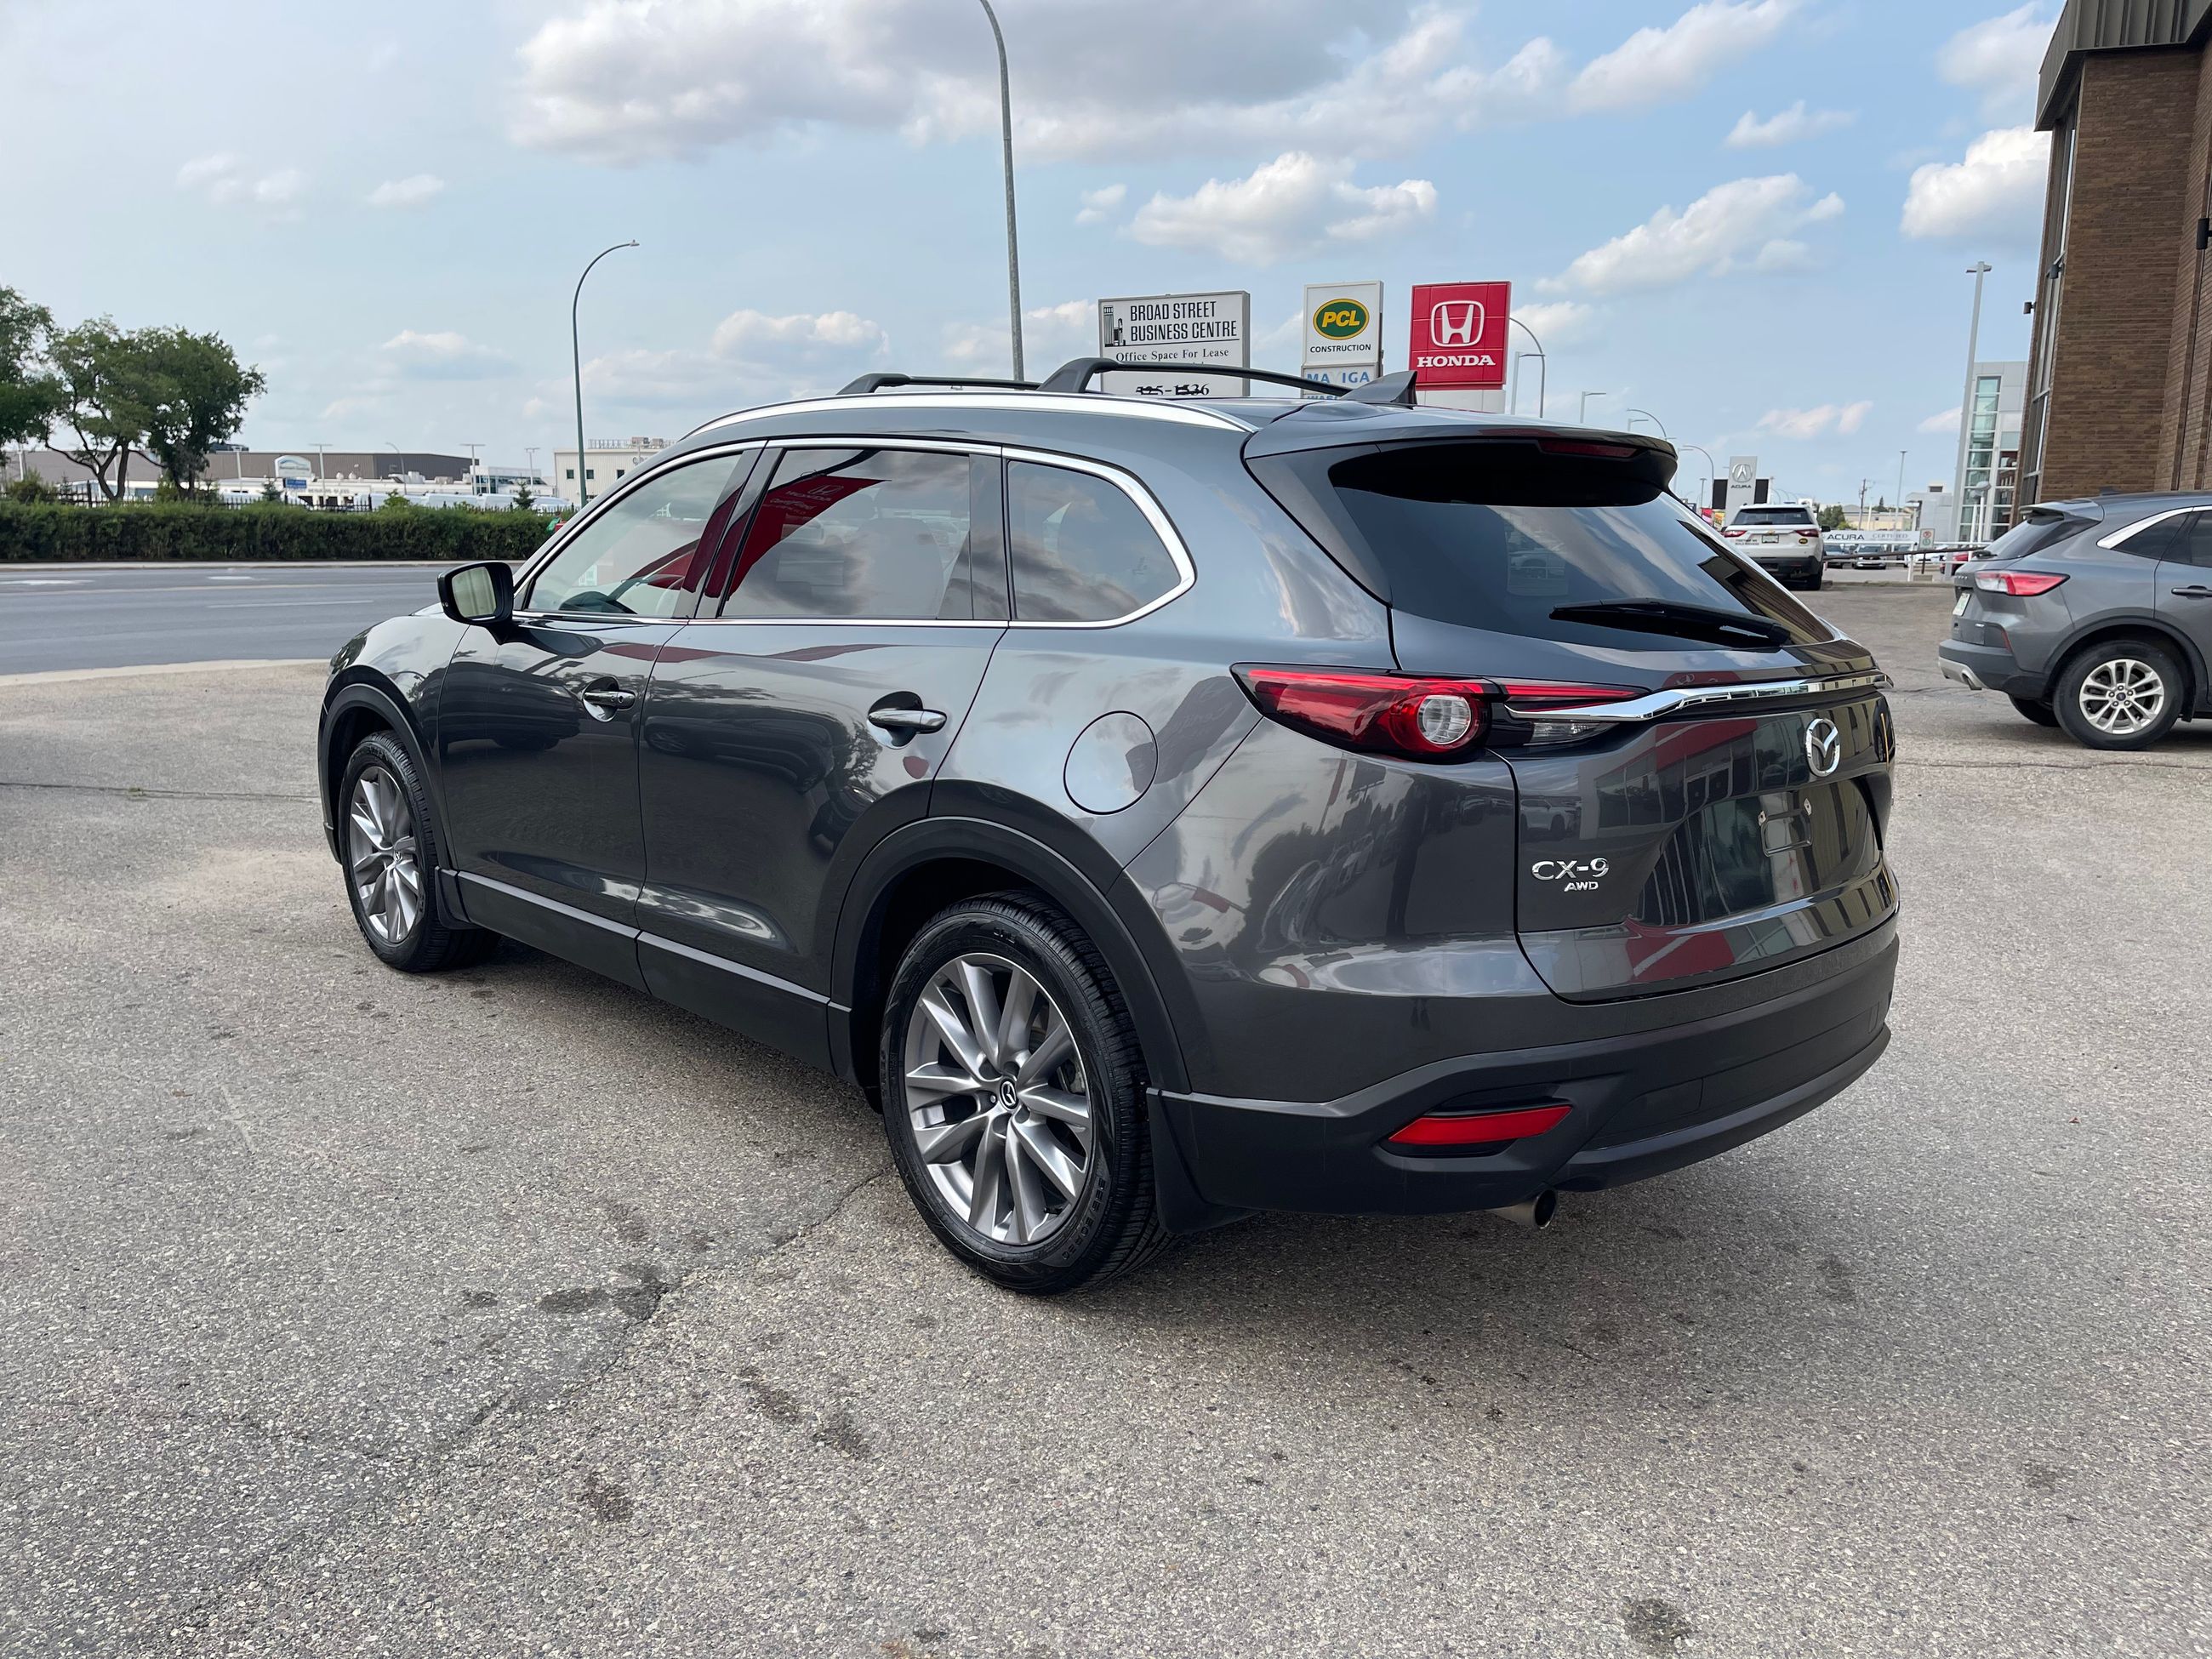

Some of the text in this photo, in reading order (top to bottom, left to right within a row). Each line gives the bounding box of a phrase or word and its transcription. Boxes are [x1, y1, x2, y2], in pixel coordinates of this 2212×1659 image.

[1130, 301, 1217, 322] BROAD STREET
[1321, 310, 1360, 328] PCL
[1131, 320, 1237, 341] BUSINESS CENTRE
[1115, 348, 1229, 362] Office Space For Lease
[1310, 344, 1371, 353] CONSTRUCTION
[1417, 355, 1496, 368] HONDA
[1531, 857, 1610, 881] CX-9
[1564, 881, 1599, 892] AWD
